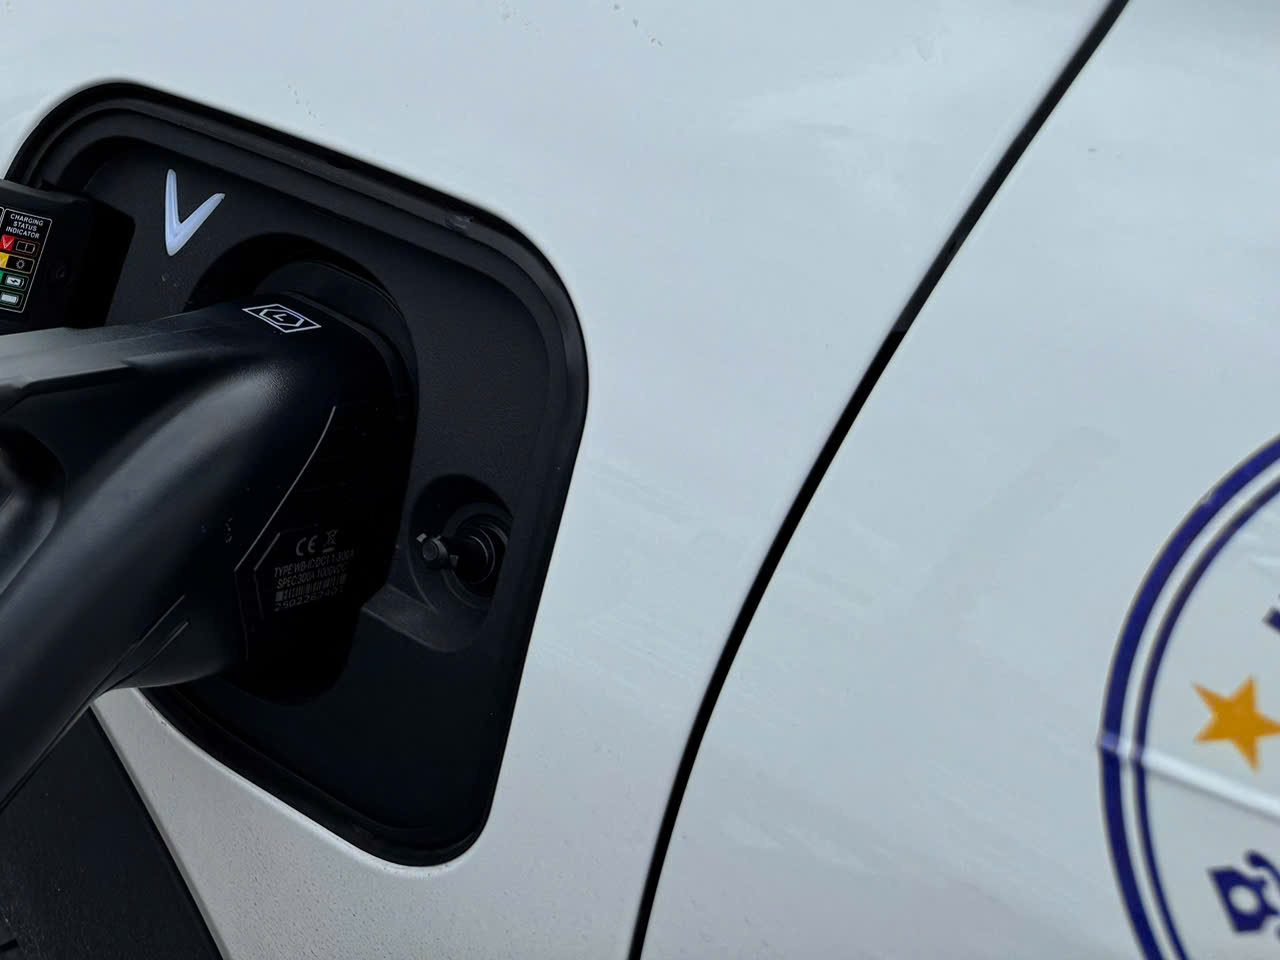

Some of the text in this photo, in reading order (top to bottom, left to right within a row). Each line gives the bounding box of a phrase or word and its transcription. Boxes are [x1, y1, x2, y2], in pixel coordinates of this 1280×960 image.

[10, 213, 44, 226] CHARGING
[6, 226, 40, 239] INDICATOR
[13, 221, 38, 232] STATUS
